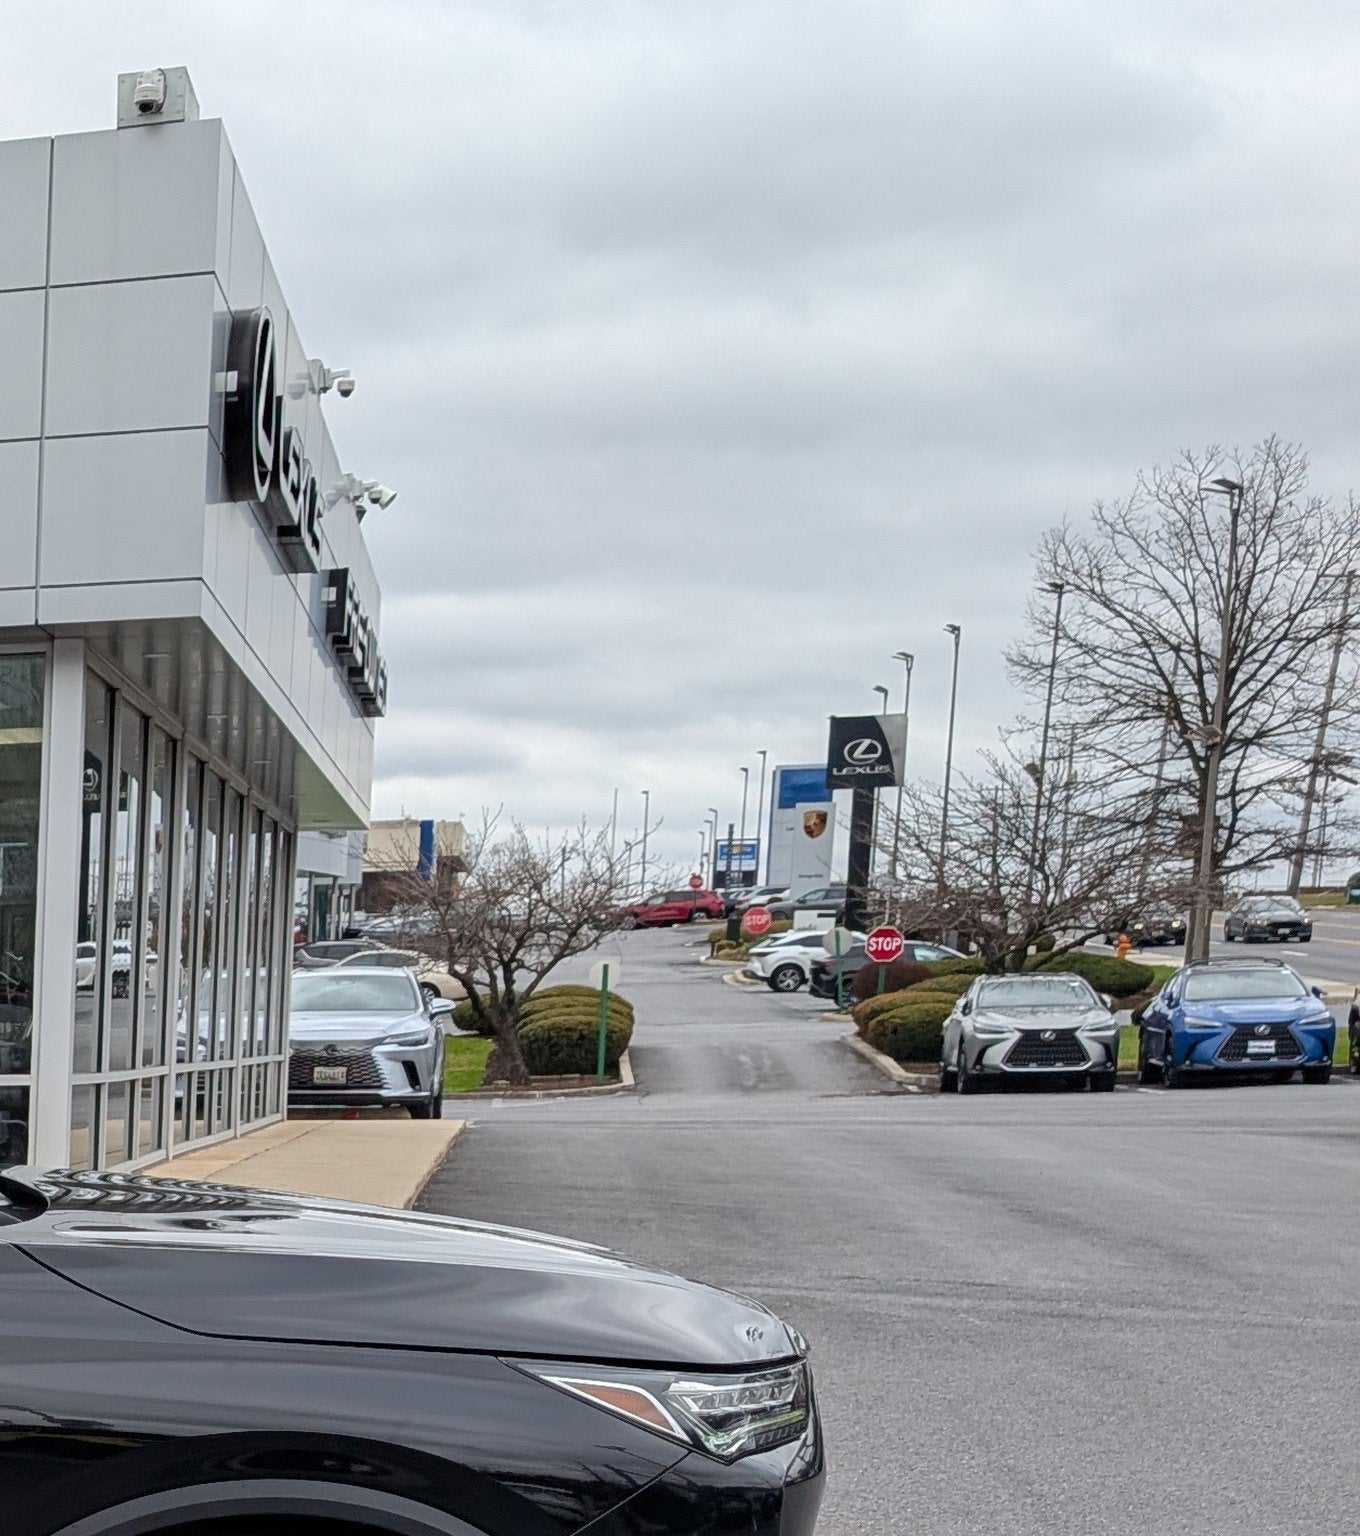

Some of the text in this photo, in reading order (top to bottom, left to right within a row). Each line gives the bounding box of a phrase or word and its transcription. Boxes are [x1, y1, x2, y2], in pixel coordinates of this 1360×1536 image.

[832, 764, 892, 776] LEXUS
[743, 914, 771, 926] STOP
[868, 936, 901, 952] STOP
